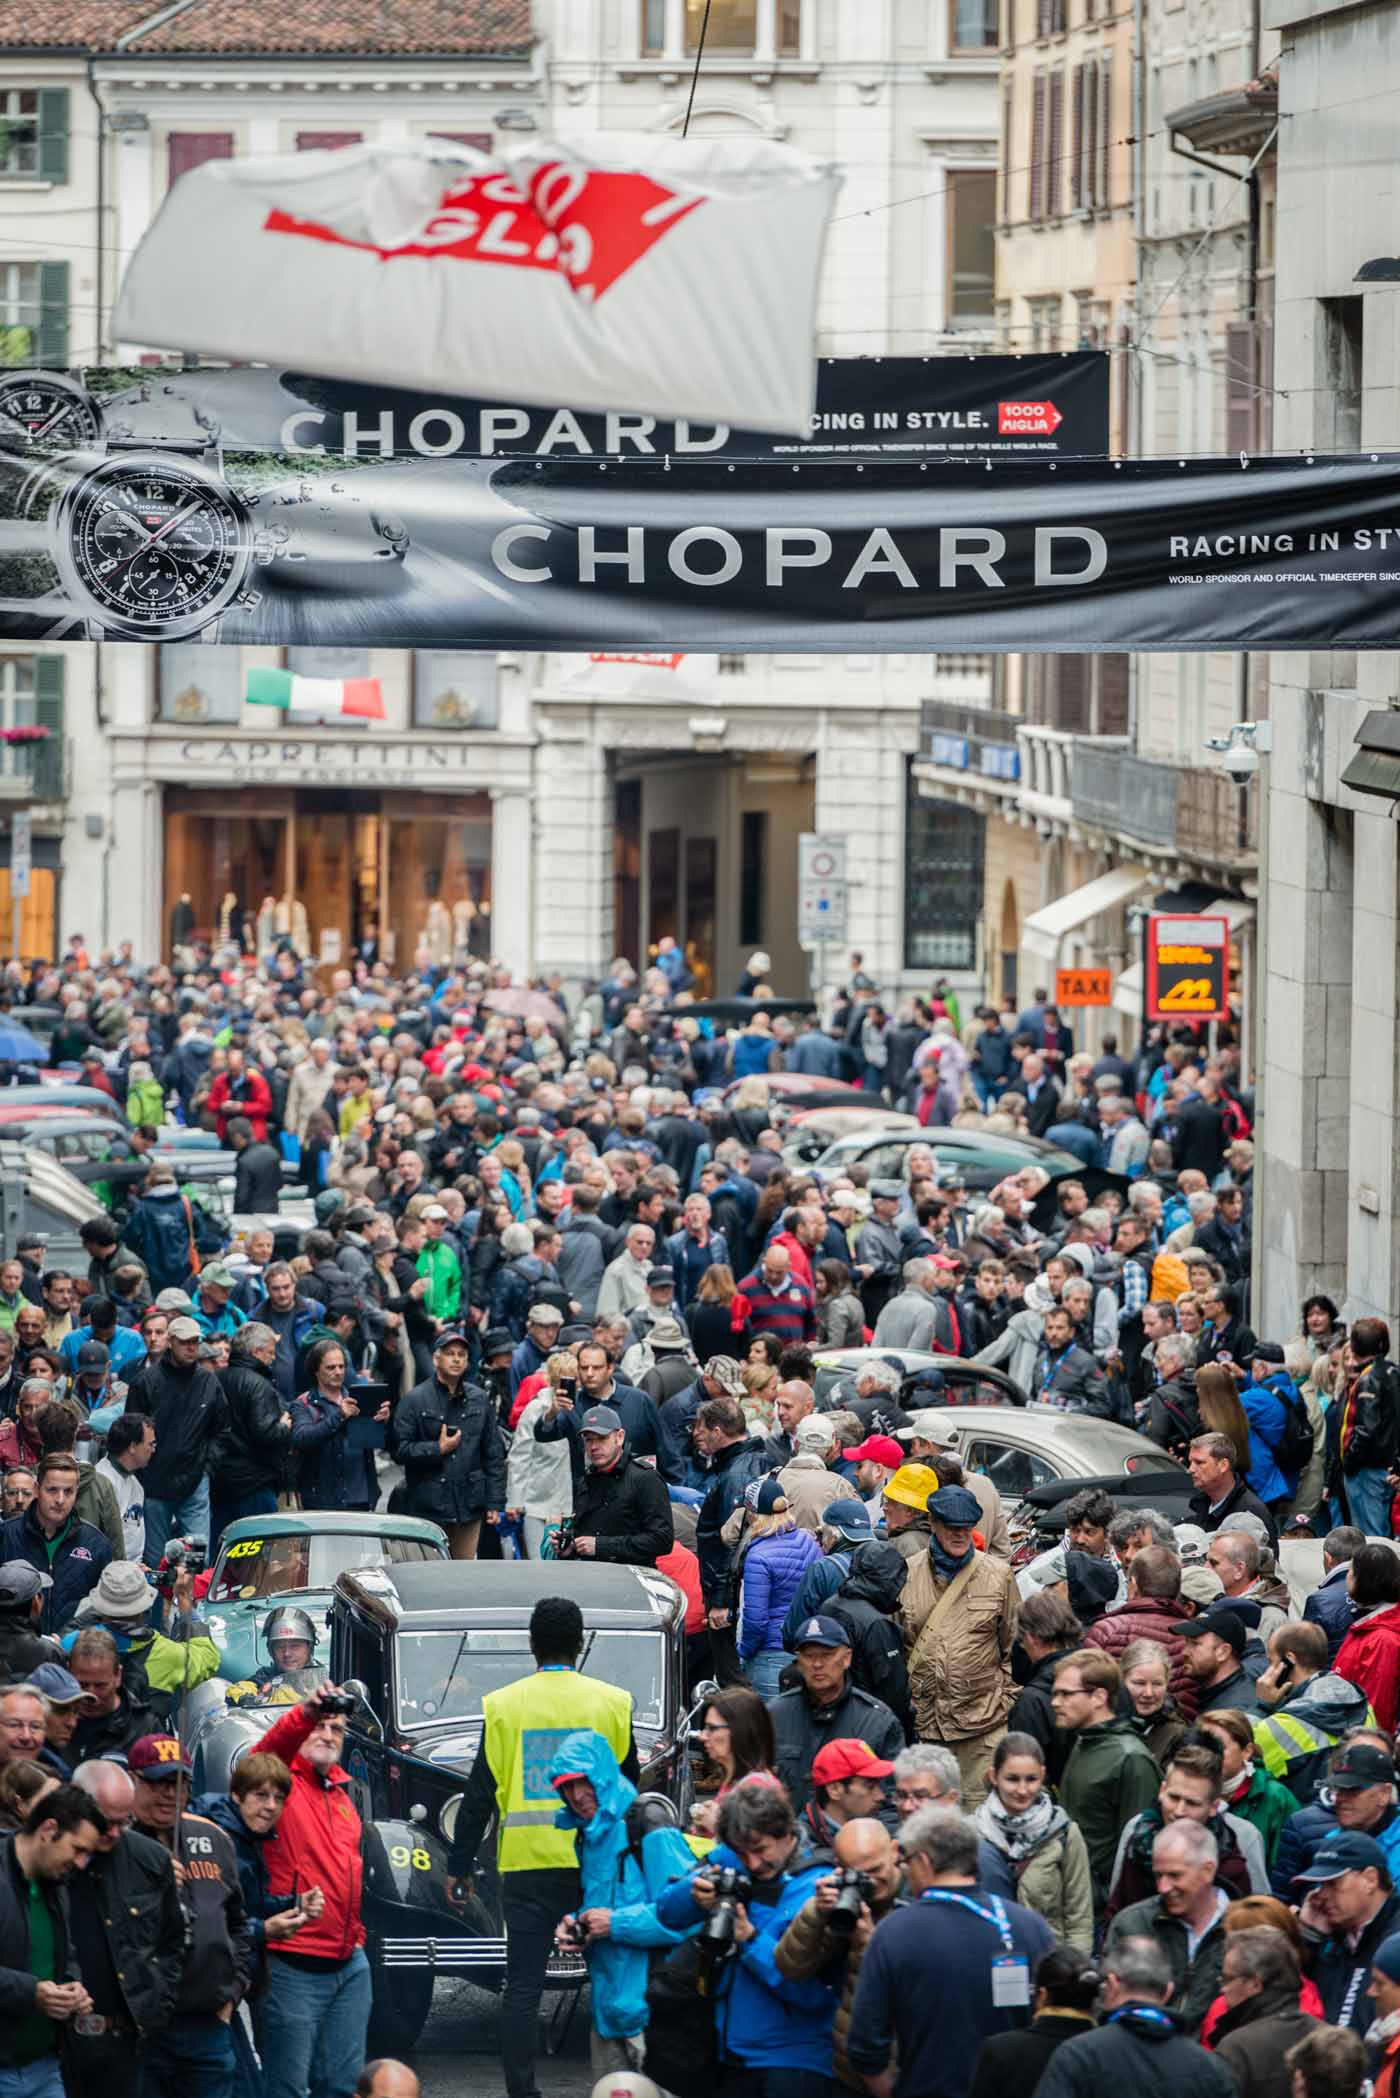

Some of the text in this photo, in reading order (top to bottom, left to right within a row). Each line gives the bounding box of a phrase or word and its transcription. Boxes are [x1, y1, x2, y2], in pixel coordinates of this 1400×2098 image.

[26, 396, 41, 410] 12
[1005, 406, 1045, 417] 1000
[874, 412, 898, 429] IN
[906, 411, 989, 429] STYLE.
[1002, 420, 1048, 431] MIGLIA
[279, 408, 731, 458] CHOPARD
[144, 485, 165, 500] 12
[133, 503, 175, 512] CHOPARD
[1170, 534, 1294, 557] RACING
[1309, 532, 1339, 550] IN
[490, 526, 1109, 588] CHOPARD
[1169, 576, 1203, 584] WORLD
[1205, 575, 1251, 583] SPONSOR
[1253, 574, 1274, 583] AND
[1275, 574, 1317, 582] OFFICIAL
[1319, 573, 1377, 581] TIMEKEEPER
[182, 741, 469, 765] CAPRETTINI
[1058, 977, 1110, 995] TAXI
[226, 1540, 265, 1558] 435
[186, 1837, 212, 1854] 76
[390, 1845, 432, 1871] 98
